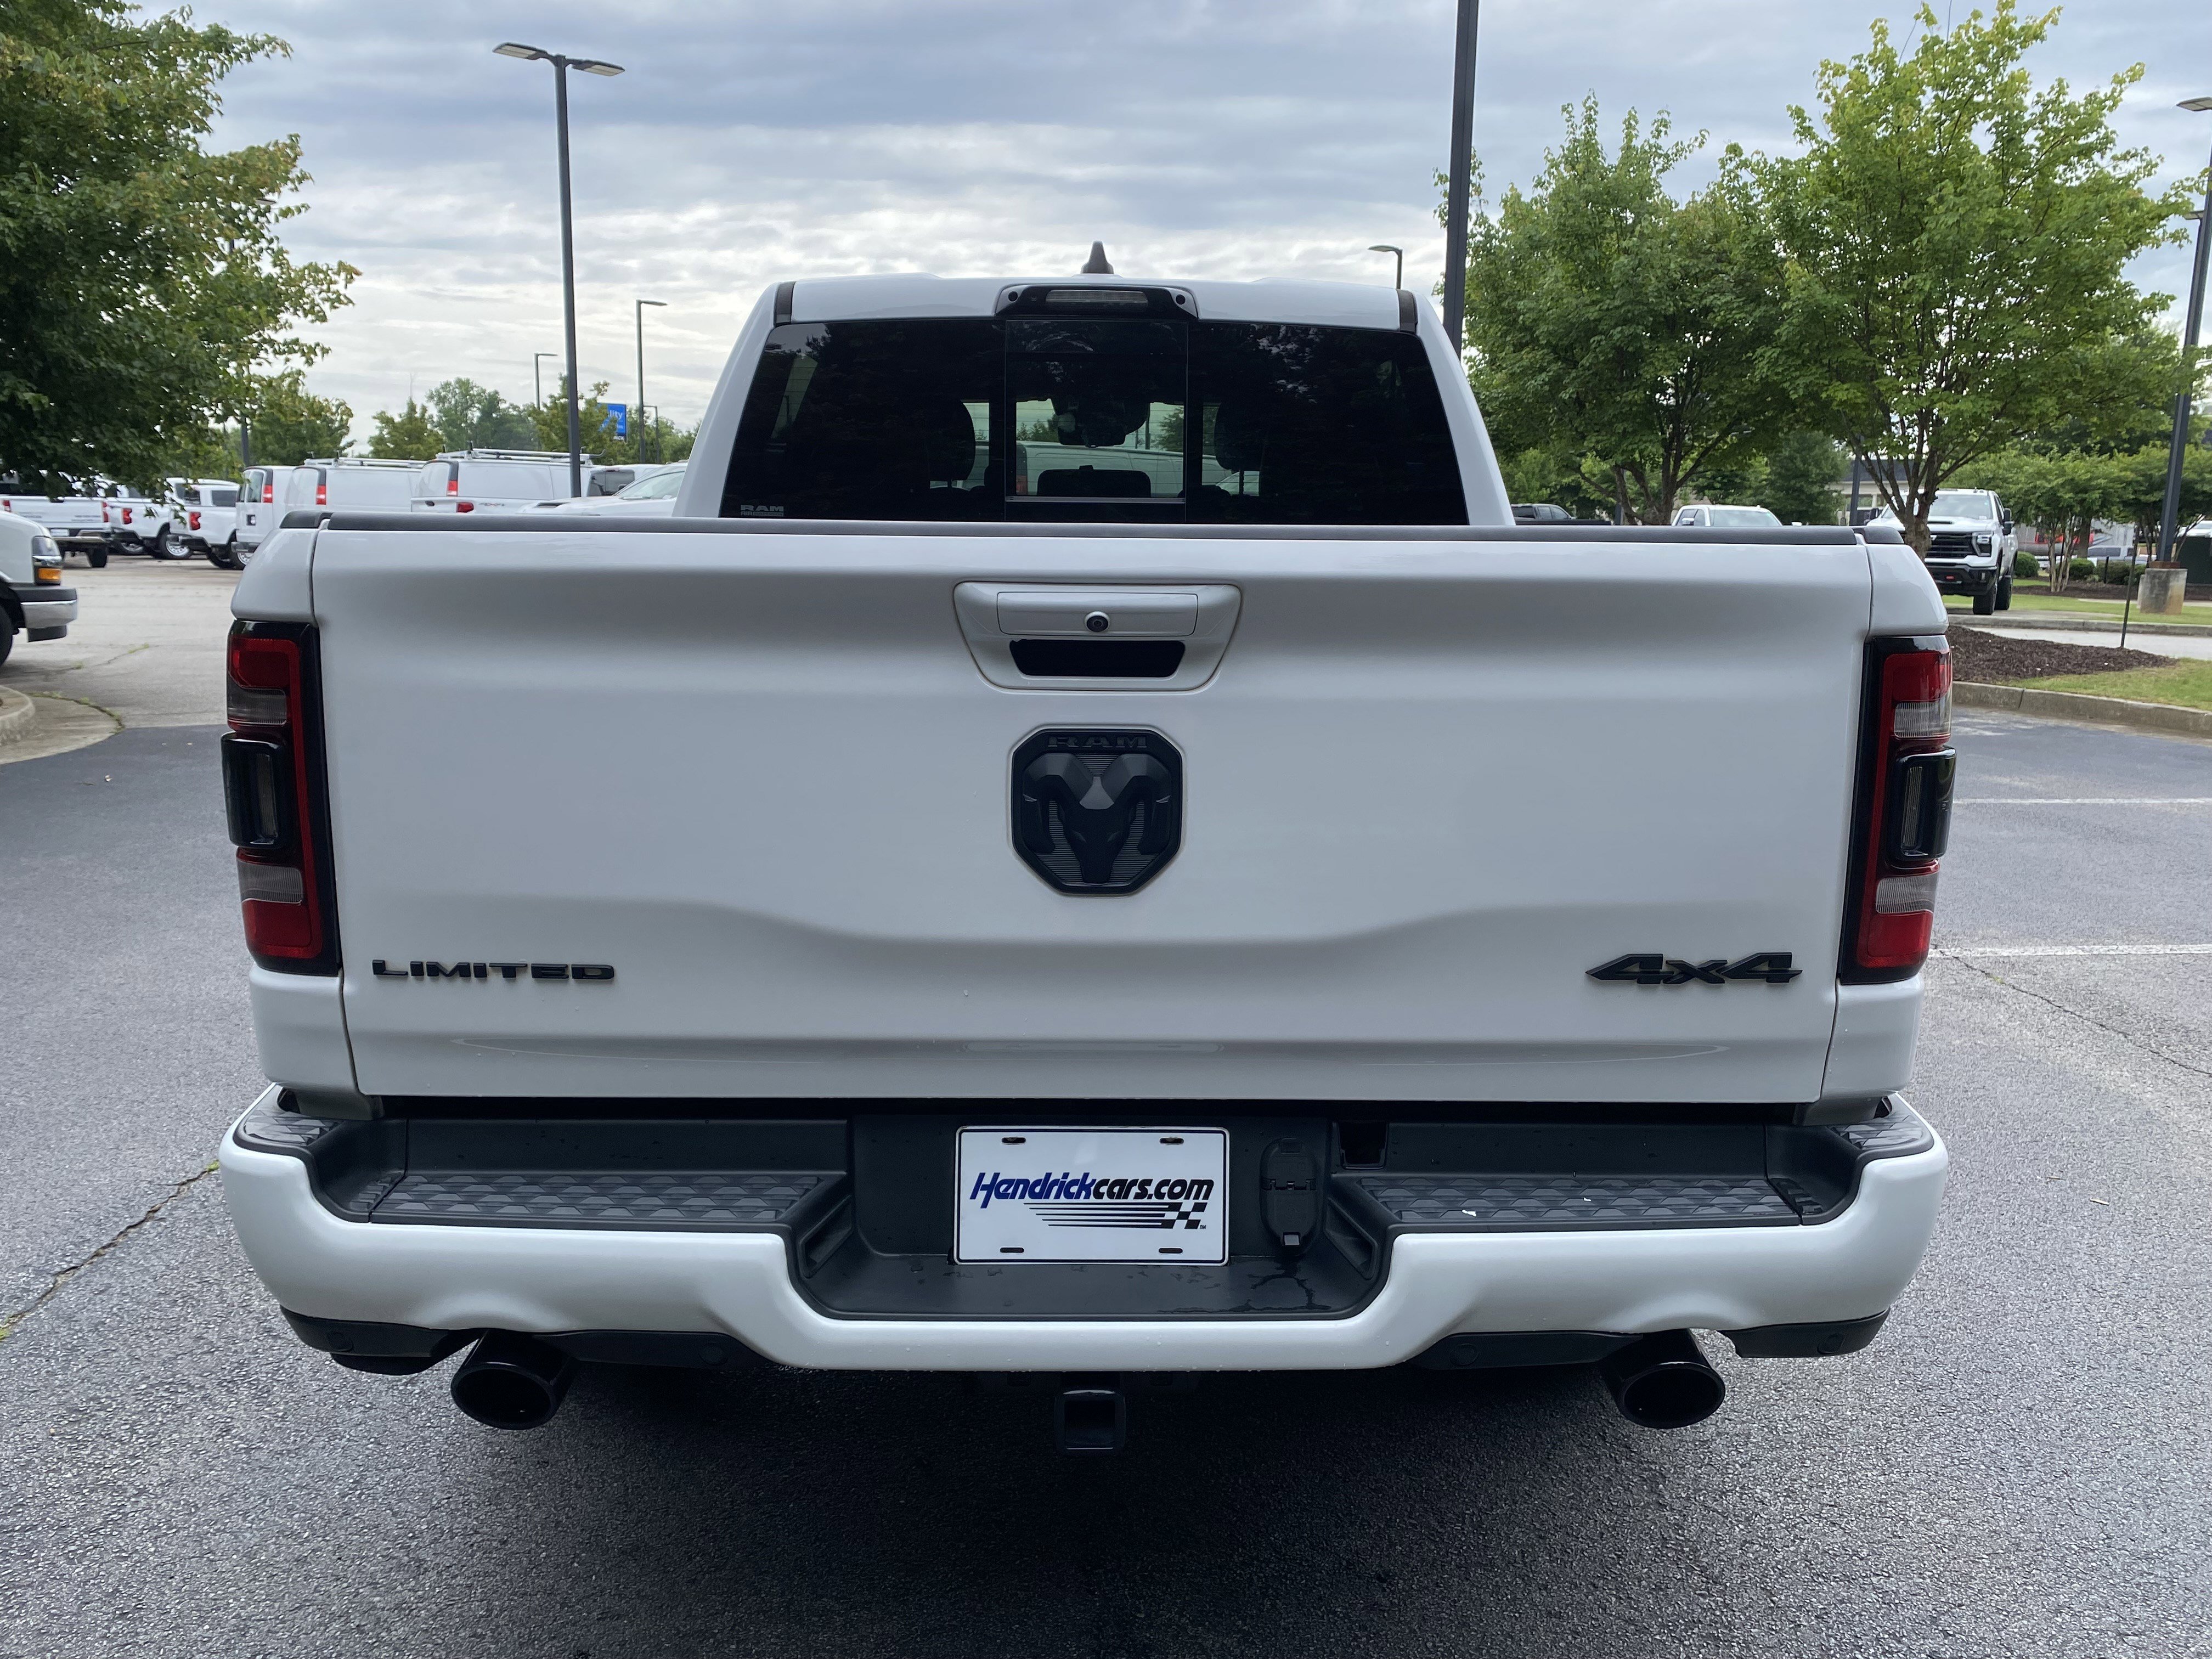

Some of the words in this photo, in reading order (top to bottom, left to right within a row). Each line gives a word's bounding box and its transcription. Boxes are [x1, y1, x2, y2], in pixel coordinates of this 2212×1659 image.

[1047, 736, 1148, 749] RAM
[371, 958, 615, 980] LIMITED
[969, 1172, 1215, 1210] Hendrickcars.com
